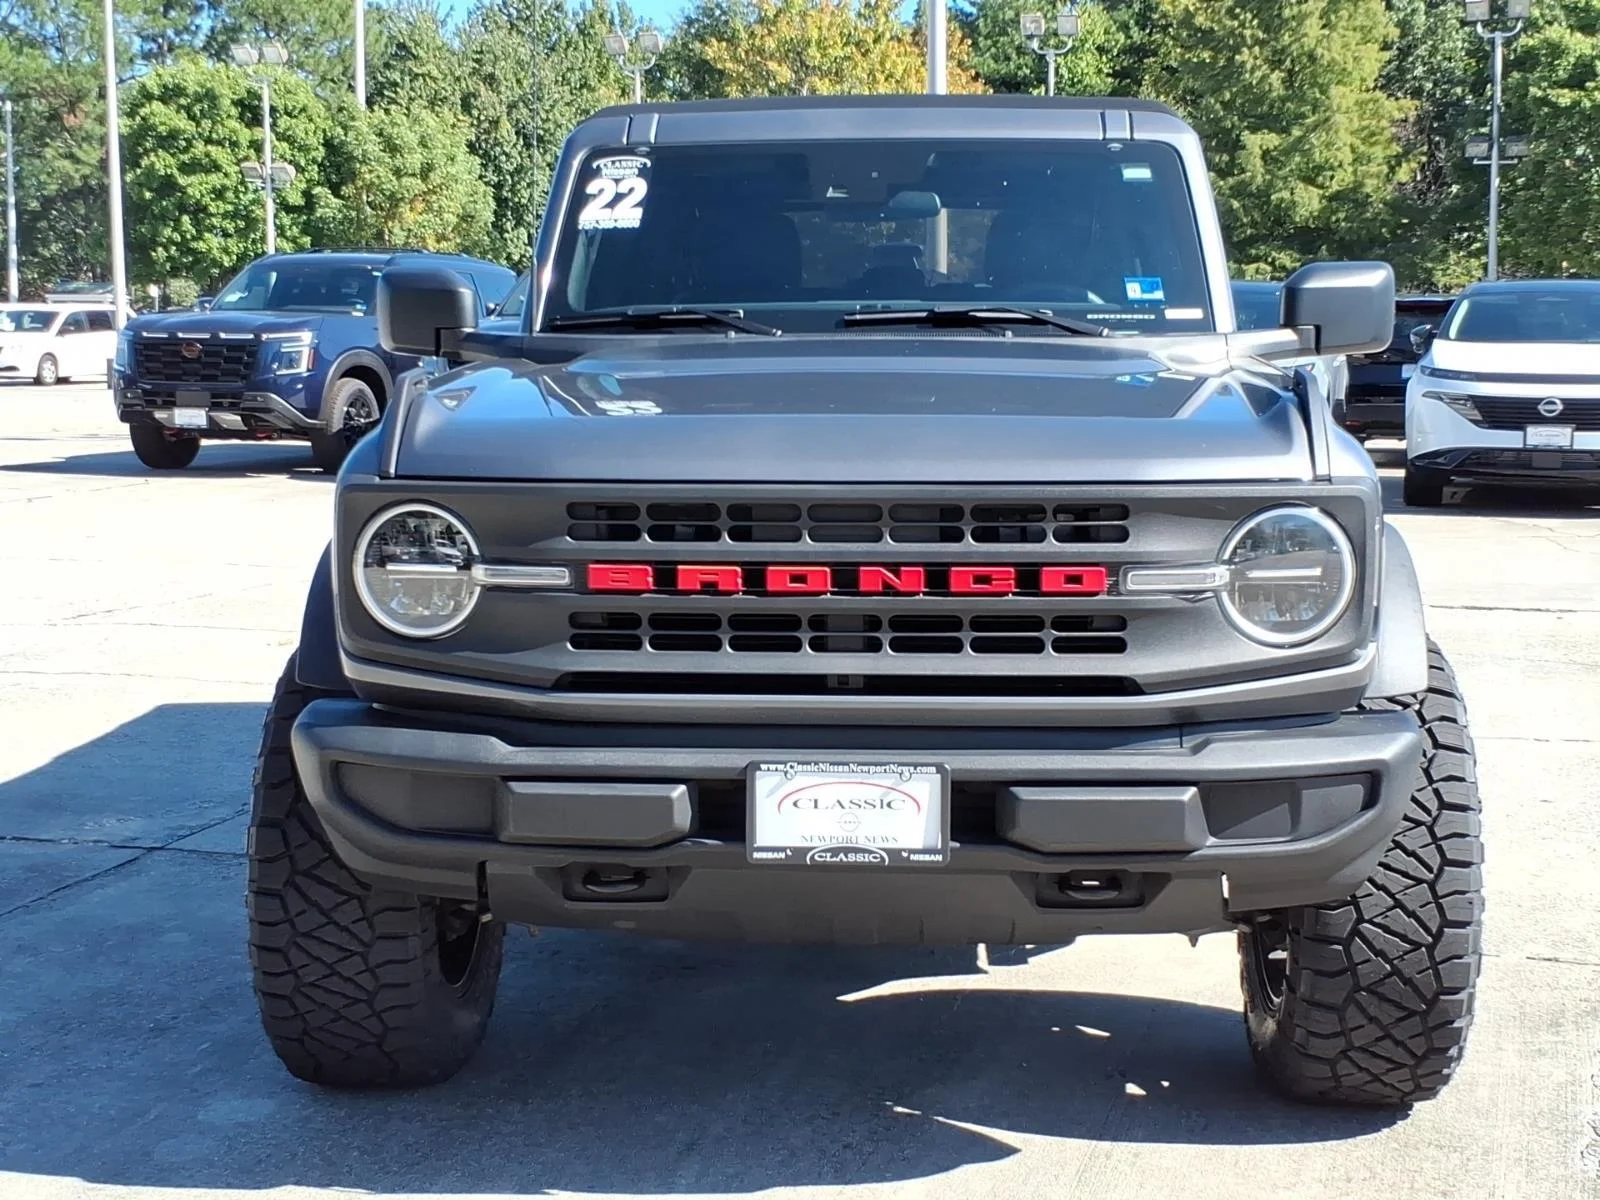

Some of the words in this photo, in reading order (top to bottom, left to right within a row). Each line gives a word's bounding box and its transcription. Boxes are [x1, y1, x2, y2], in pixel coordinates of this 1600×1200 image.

[600, 160, 644, 169] CLASSIC
[579, 177, 648, 220] 22
[587, 564, 1107, 593] BRONCO
[760, 762, 936, 774] www.ClassicNissanNewportNews.com
[792, 798, 905, 810] CLASSIC
[801, 835, 859, 844] NEWPORT
[864, 836, 898, 844] NEWS
[753, 851, 785, 859] NISSAN
[814, 852, 881, 862] CLASSIC
[910, 853, 943, 861] NISSAN
